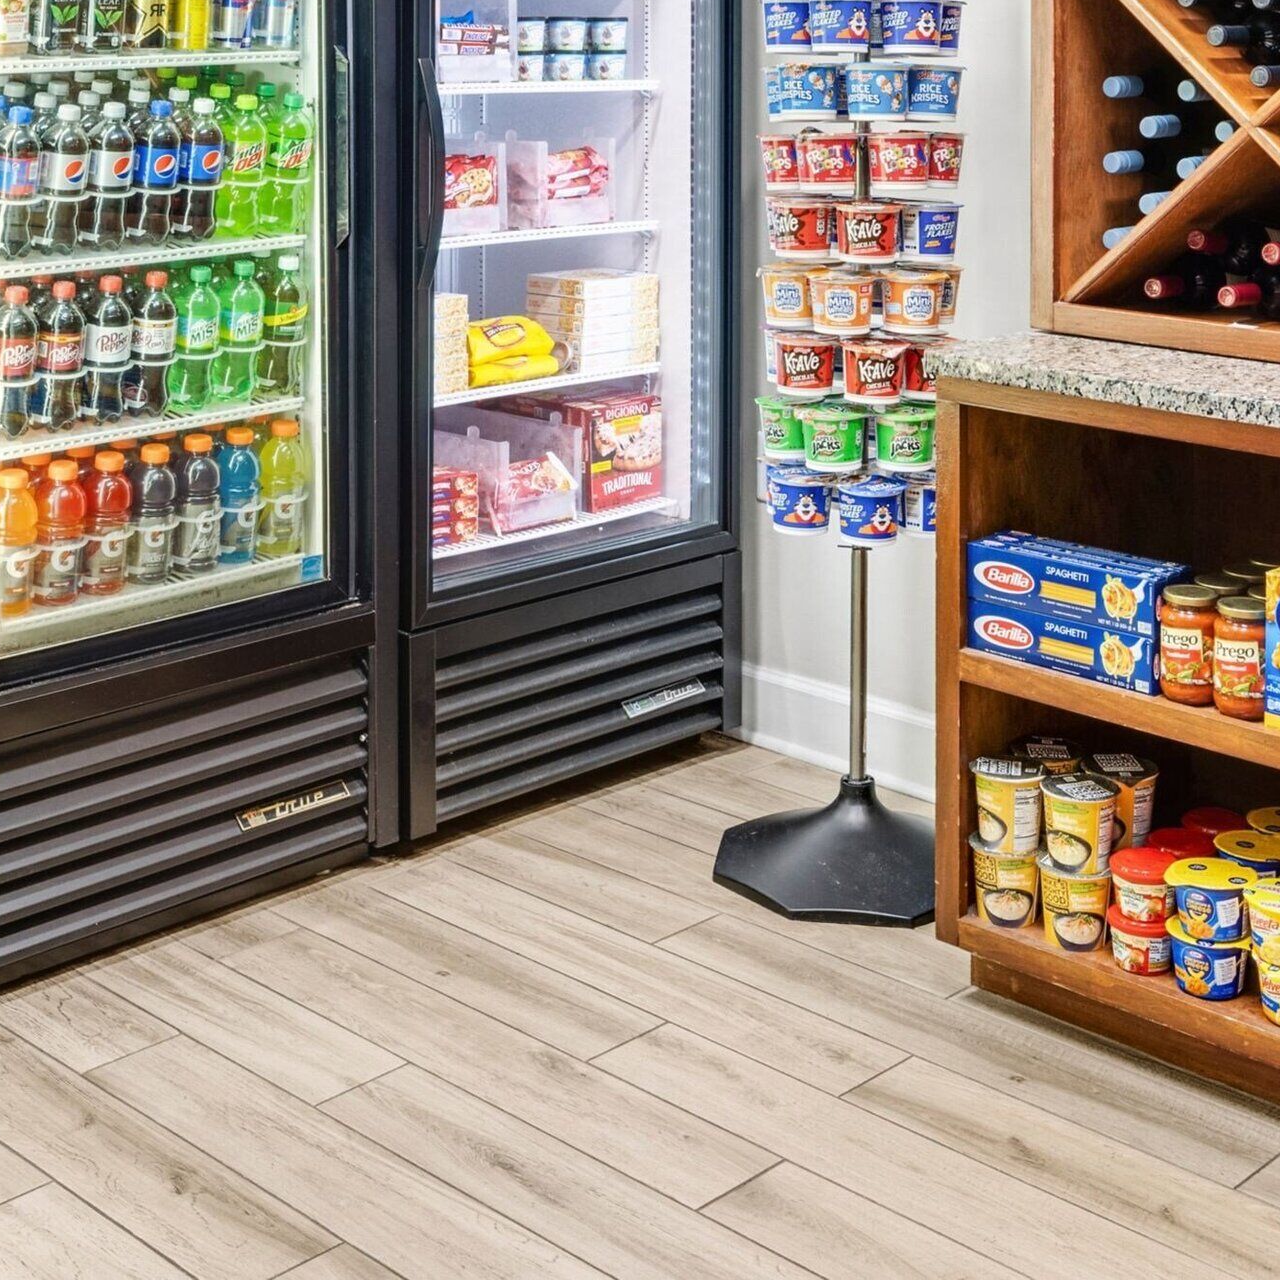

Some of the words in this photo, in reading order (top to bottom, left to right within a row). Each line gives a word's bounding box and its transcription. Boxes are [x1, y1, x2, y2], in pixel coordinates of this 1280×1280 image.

[784, 80, 803, 90] RICE
[851, 84, 870, 94] RICE
[920, 84, 941, 94] RICE
[911, 94, 949, 104] KRISPIES
[806, 145, 842, 164] FROOT
[879, 145, 916, 163] FROOT
[813, 157, 843, 174] LOOPS
[885, 157, 917, 173] LOOPS
[96, 337, 129, 354] Pepper
[605, 402, 648, 420] DIGIORNO
[812, 439, 841, 456] JACKS
[890, 440, 921, 456] JACKS
[602, 472, 653, 495] TRADITIONAL
[987, 564, 1030, 590] Barilla
[1045, 566, 1090, 583] SPAGHETTI
[985, 621, 1029, 645] Barilla
[1044, 622, 1088, 640] SPAGHETTI
[1161, 627, 1198, 648] Prego
[1216, 643, 1255, 663] Prego
